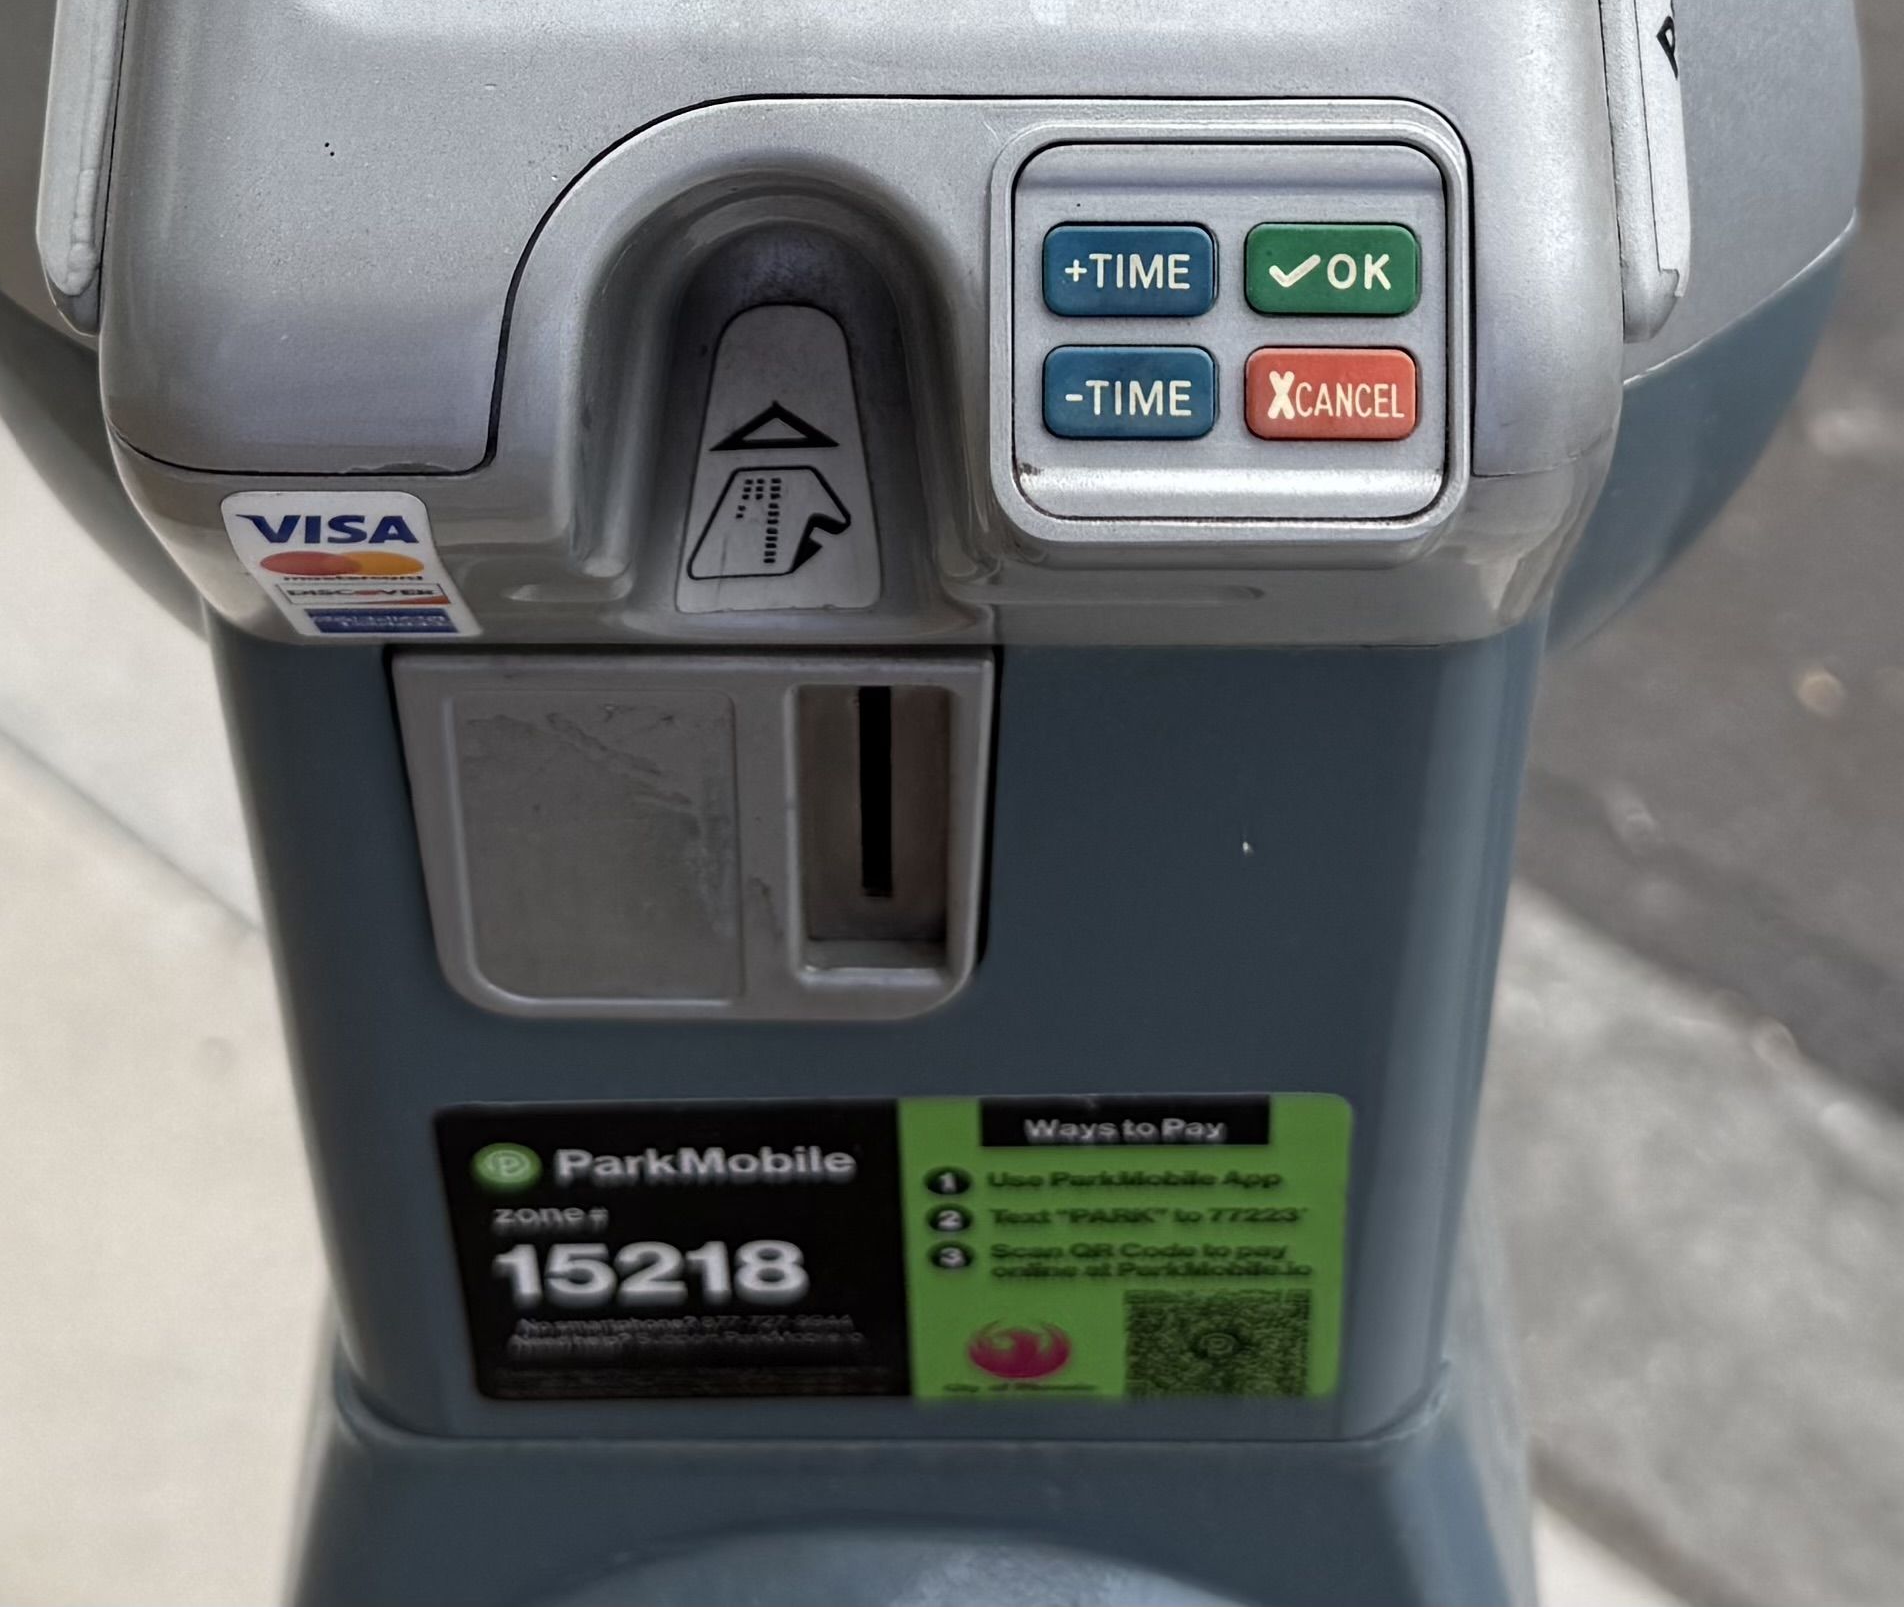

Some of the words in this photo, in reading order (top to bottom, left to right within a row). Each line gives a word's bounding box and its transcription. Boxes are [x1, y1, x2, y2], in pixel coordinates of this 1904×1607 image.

[1064, 252, 1191, 291] +TIME
[1326, 253, 1392, 291] OK
[1065, 379, 1192, 417] -TIME
[235, 513, 420, 545] VISA
[1024, 1118, 1118, 1140] Ways
[1121, 1119, 1158, 1139] to
[1161, 1118, 1226, 1140] Pay
[553, 1145, 858, 1183] ParkMobile
[940, 1171, 957, 1194] 1
[988, 1171, 1044, 1187] Use
[1049, 1170, 1219, 1186] ParkMobile
[1221, 1171, 1283, 1189] App
[937, 1209, 963, 1230] 2
[990, 1208, 1051, 1223] Text
[1174, 1208, 1203, 1222] to
[940, 1246, 966, 1267] 3
[991, 1243, 1064, 1258] Scan
[1069, 1242, 1114, 1258] QR
[1119, 1242, 1196, 1258] Code
[1201, 1243, 1233, 1257] to
[1235, 1245, 1288, 1261] pay
[991, 1262, 1078, 1278] online
[1084, 1262, 1112, 1277] at
[494, 1239, 810, 1303] 15218
